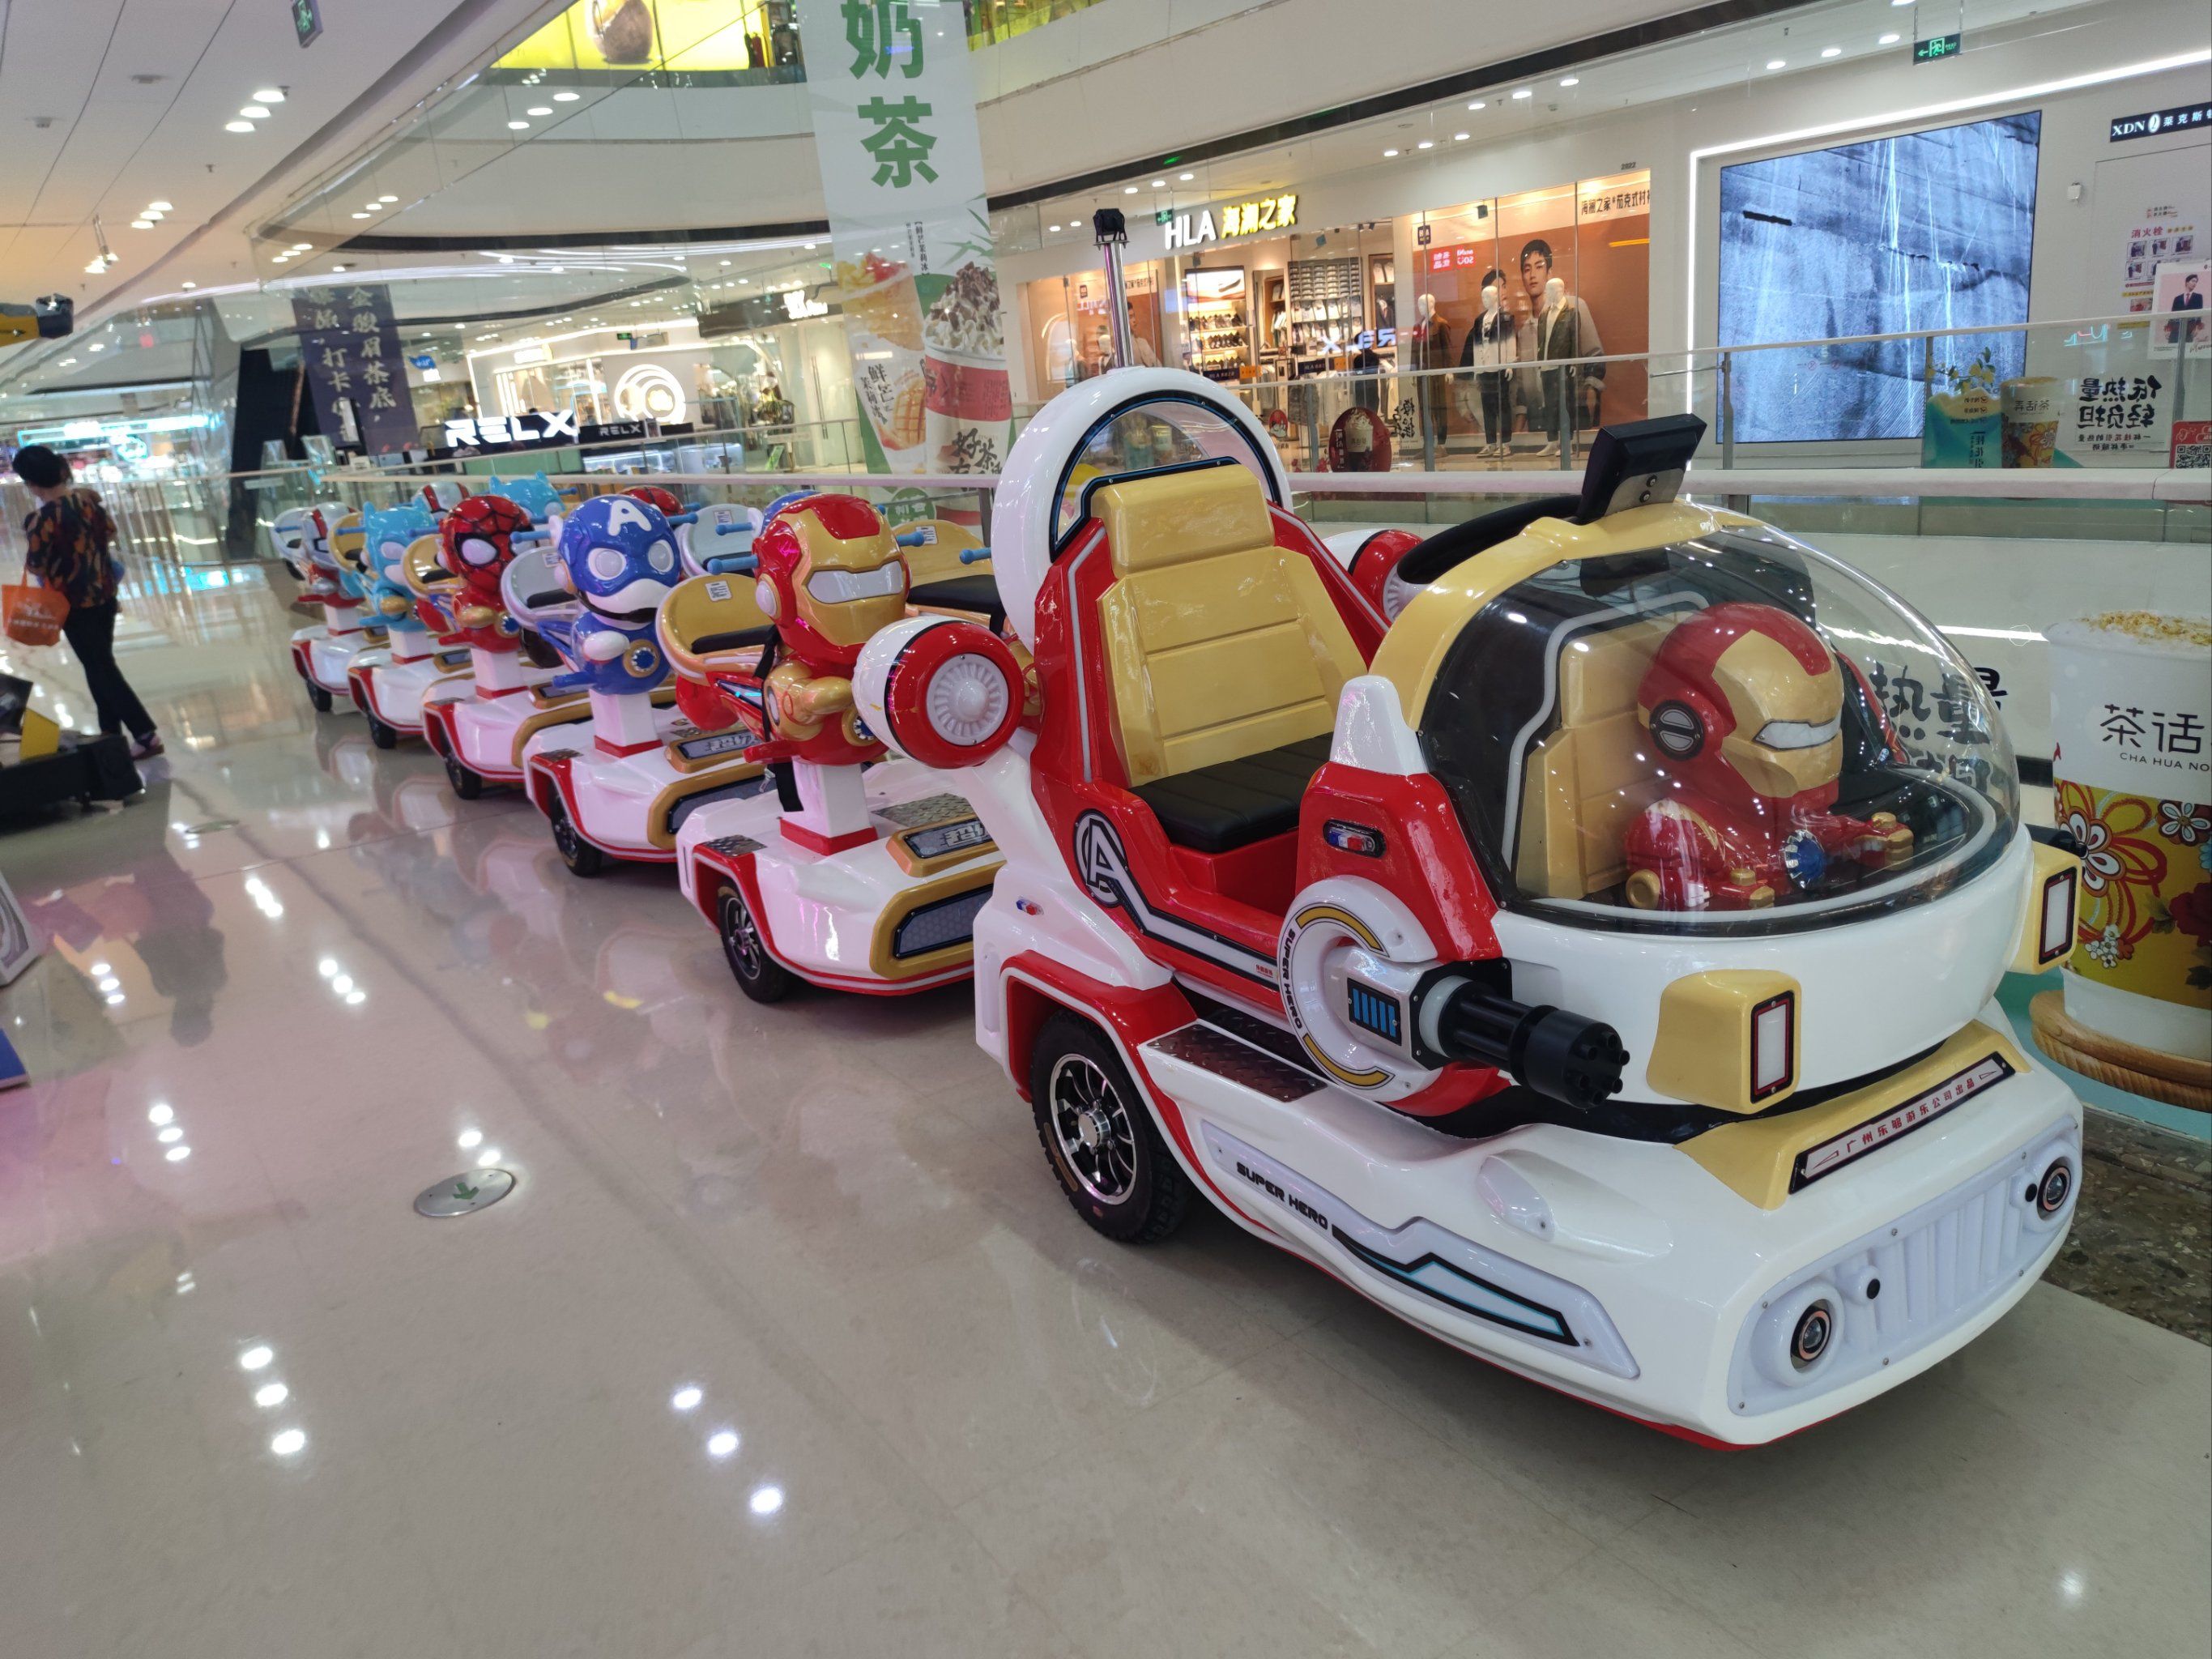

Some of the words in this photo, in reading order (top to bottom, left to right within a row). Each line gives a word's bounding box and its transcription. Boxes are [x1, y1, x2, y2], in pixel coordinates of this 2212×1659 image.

[841, 0, 940, 189] 奶茶
[2112, 121, 2146, 136] XDN
[1165, 210, 1217, 249] HLA
[1221, 194, 1297, 239] 海澜之家
[445, 410, 578, 447] RELX
[599, 422, 641, 435] RELX
[2120, 753, 2146, 764] CHA
[2153, 757, 2183, 769] HUA
[2189, 762, 2210, 772] NO
[1282, 928, 1296, 980] SUPER
[1284, 983, 1303, 1030] HERO
[1236, 1162, 1285, 1203] SUPER
[1289, 1194, 1328, 1230] HERO
